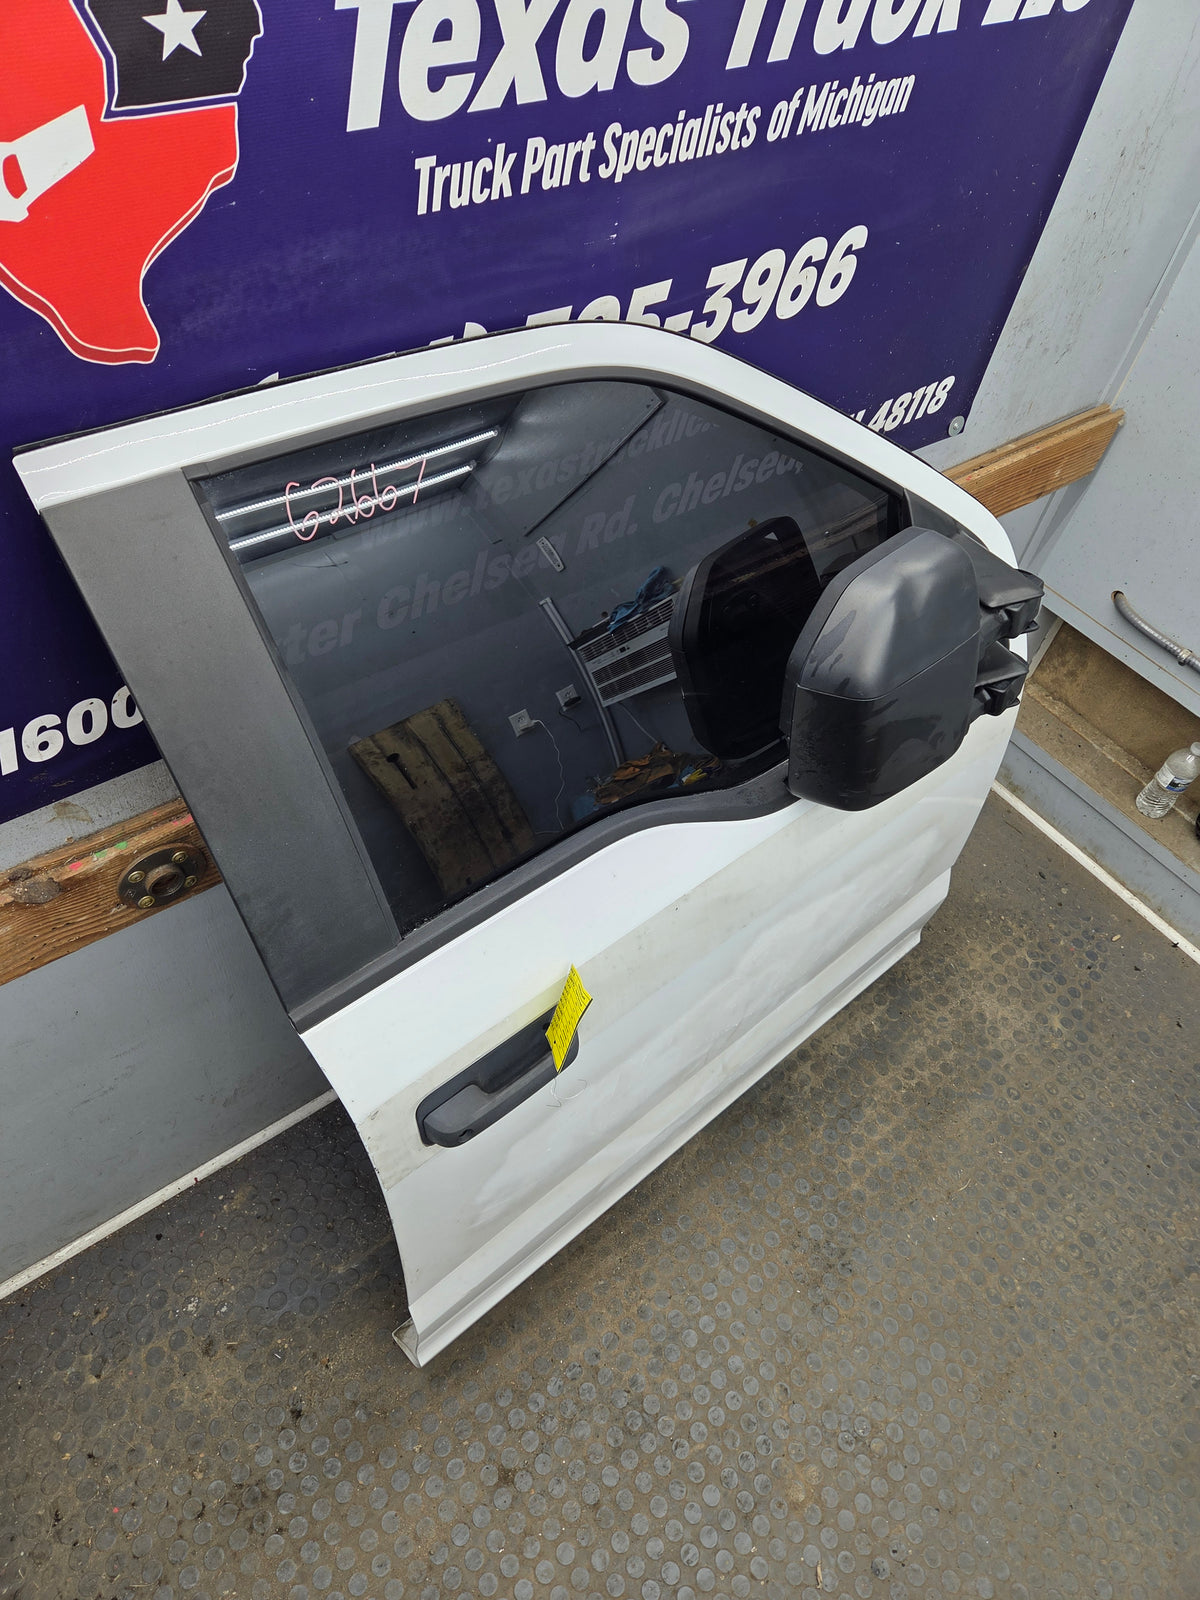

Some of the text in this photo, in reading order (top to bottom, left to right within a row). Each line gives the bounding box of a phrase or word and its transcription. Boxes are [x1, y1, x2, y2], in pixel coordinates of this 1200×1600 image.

[333, 0, 690, 132] Texas
[414, 72, 916, 216] Truck Part Specialists of Michigan
[285, 458, 427, 542] 62667
[576, 494, 639, 556] Rd.
[867, 374, 956, 433] 48118
